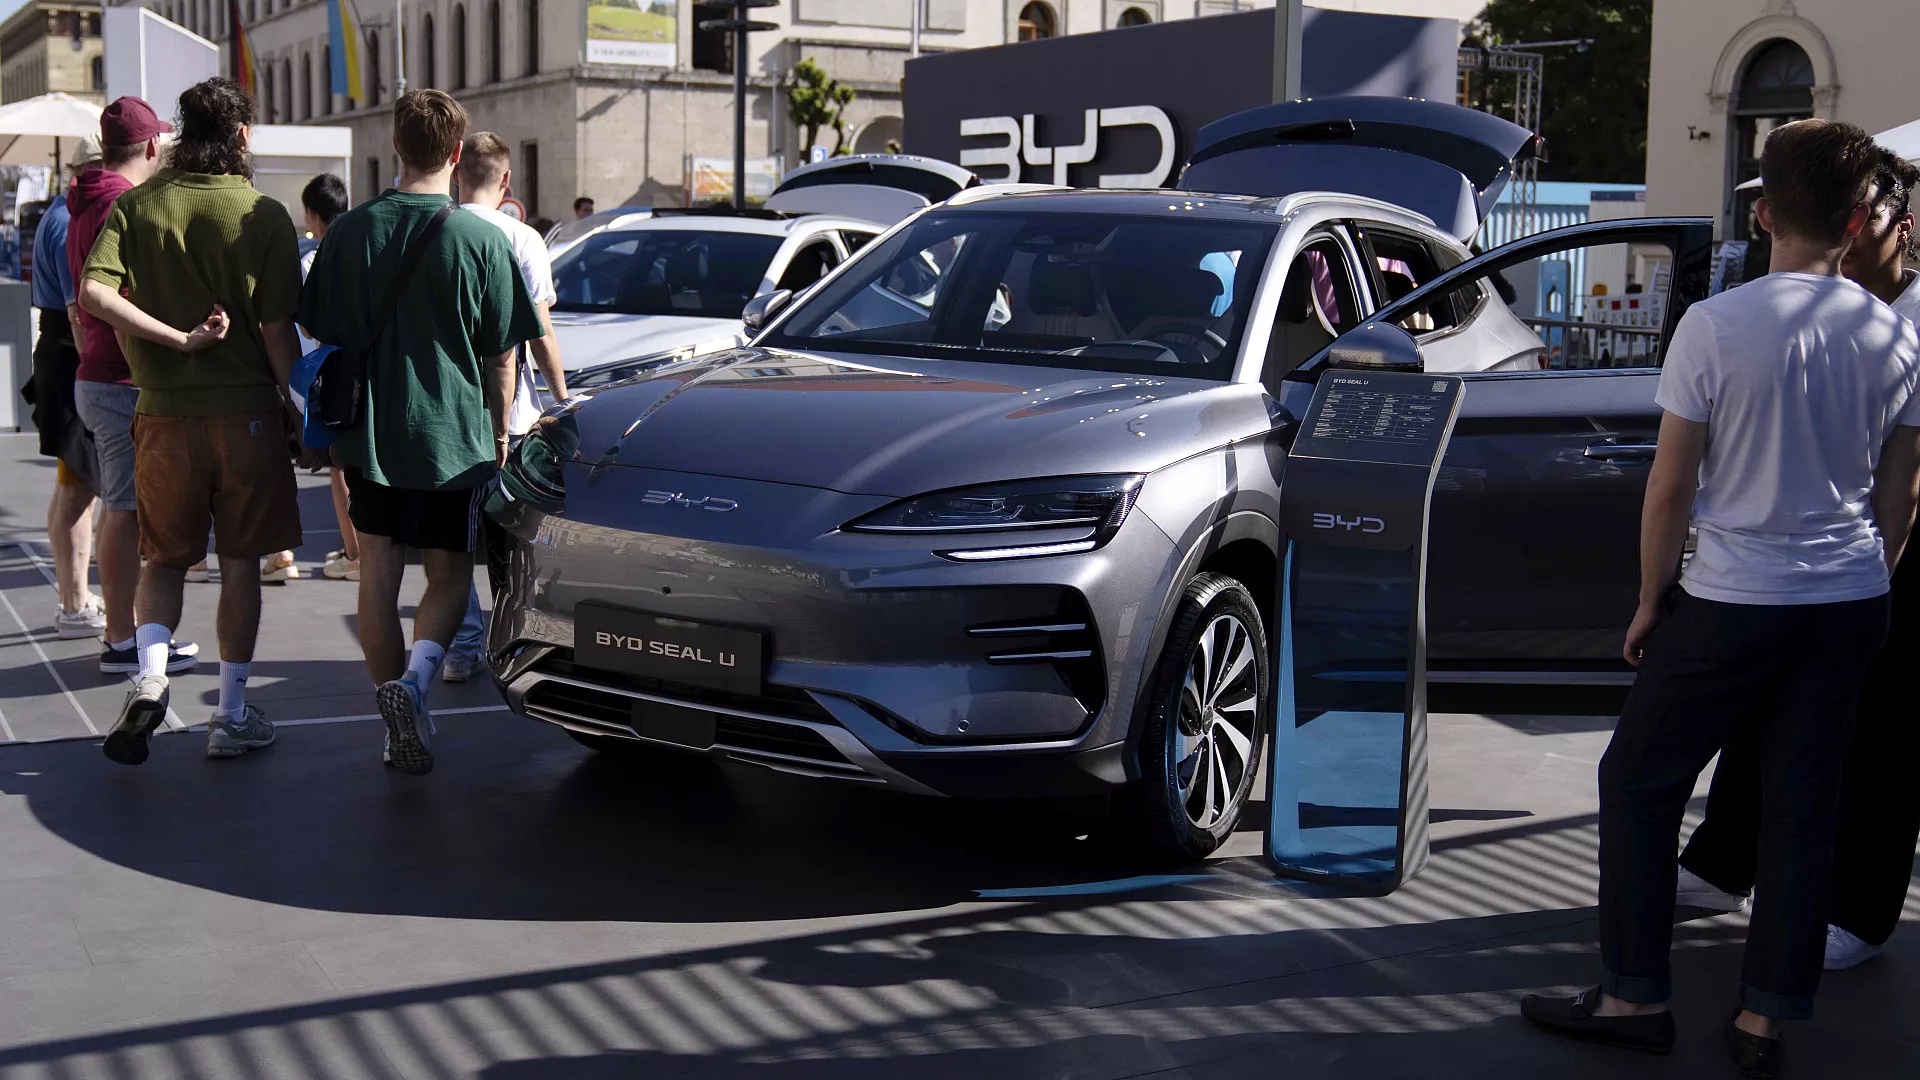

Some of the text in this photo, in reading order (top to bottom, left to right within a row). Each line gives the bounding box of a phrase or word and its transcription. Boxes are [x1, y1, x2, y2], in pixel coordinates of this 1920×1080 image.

[960, 105, 1176, 188] BYD
[641, 489, 738, 512] BYD
[1313, 512, 1385, 533] BYD
[596, 631, 735, 667] BYD SEAL U
